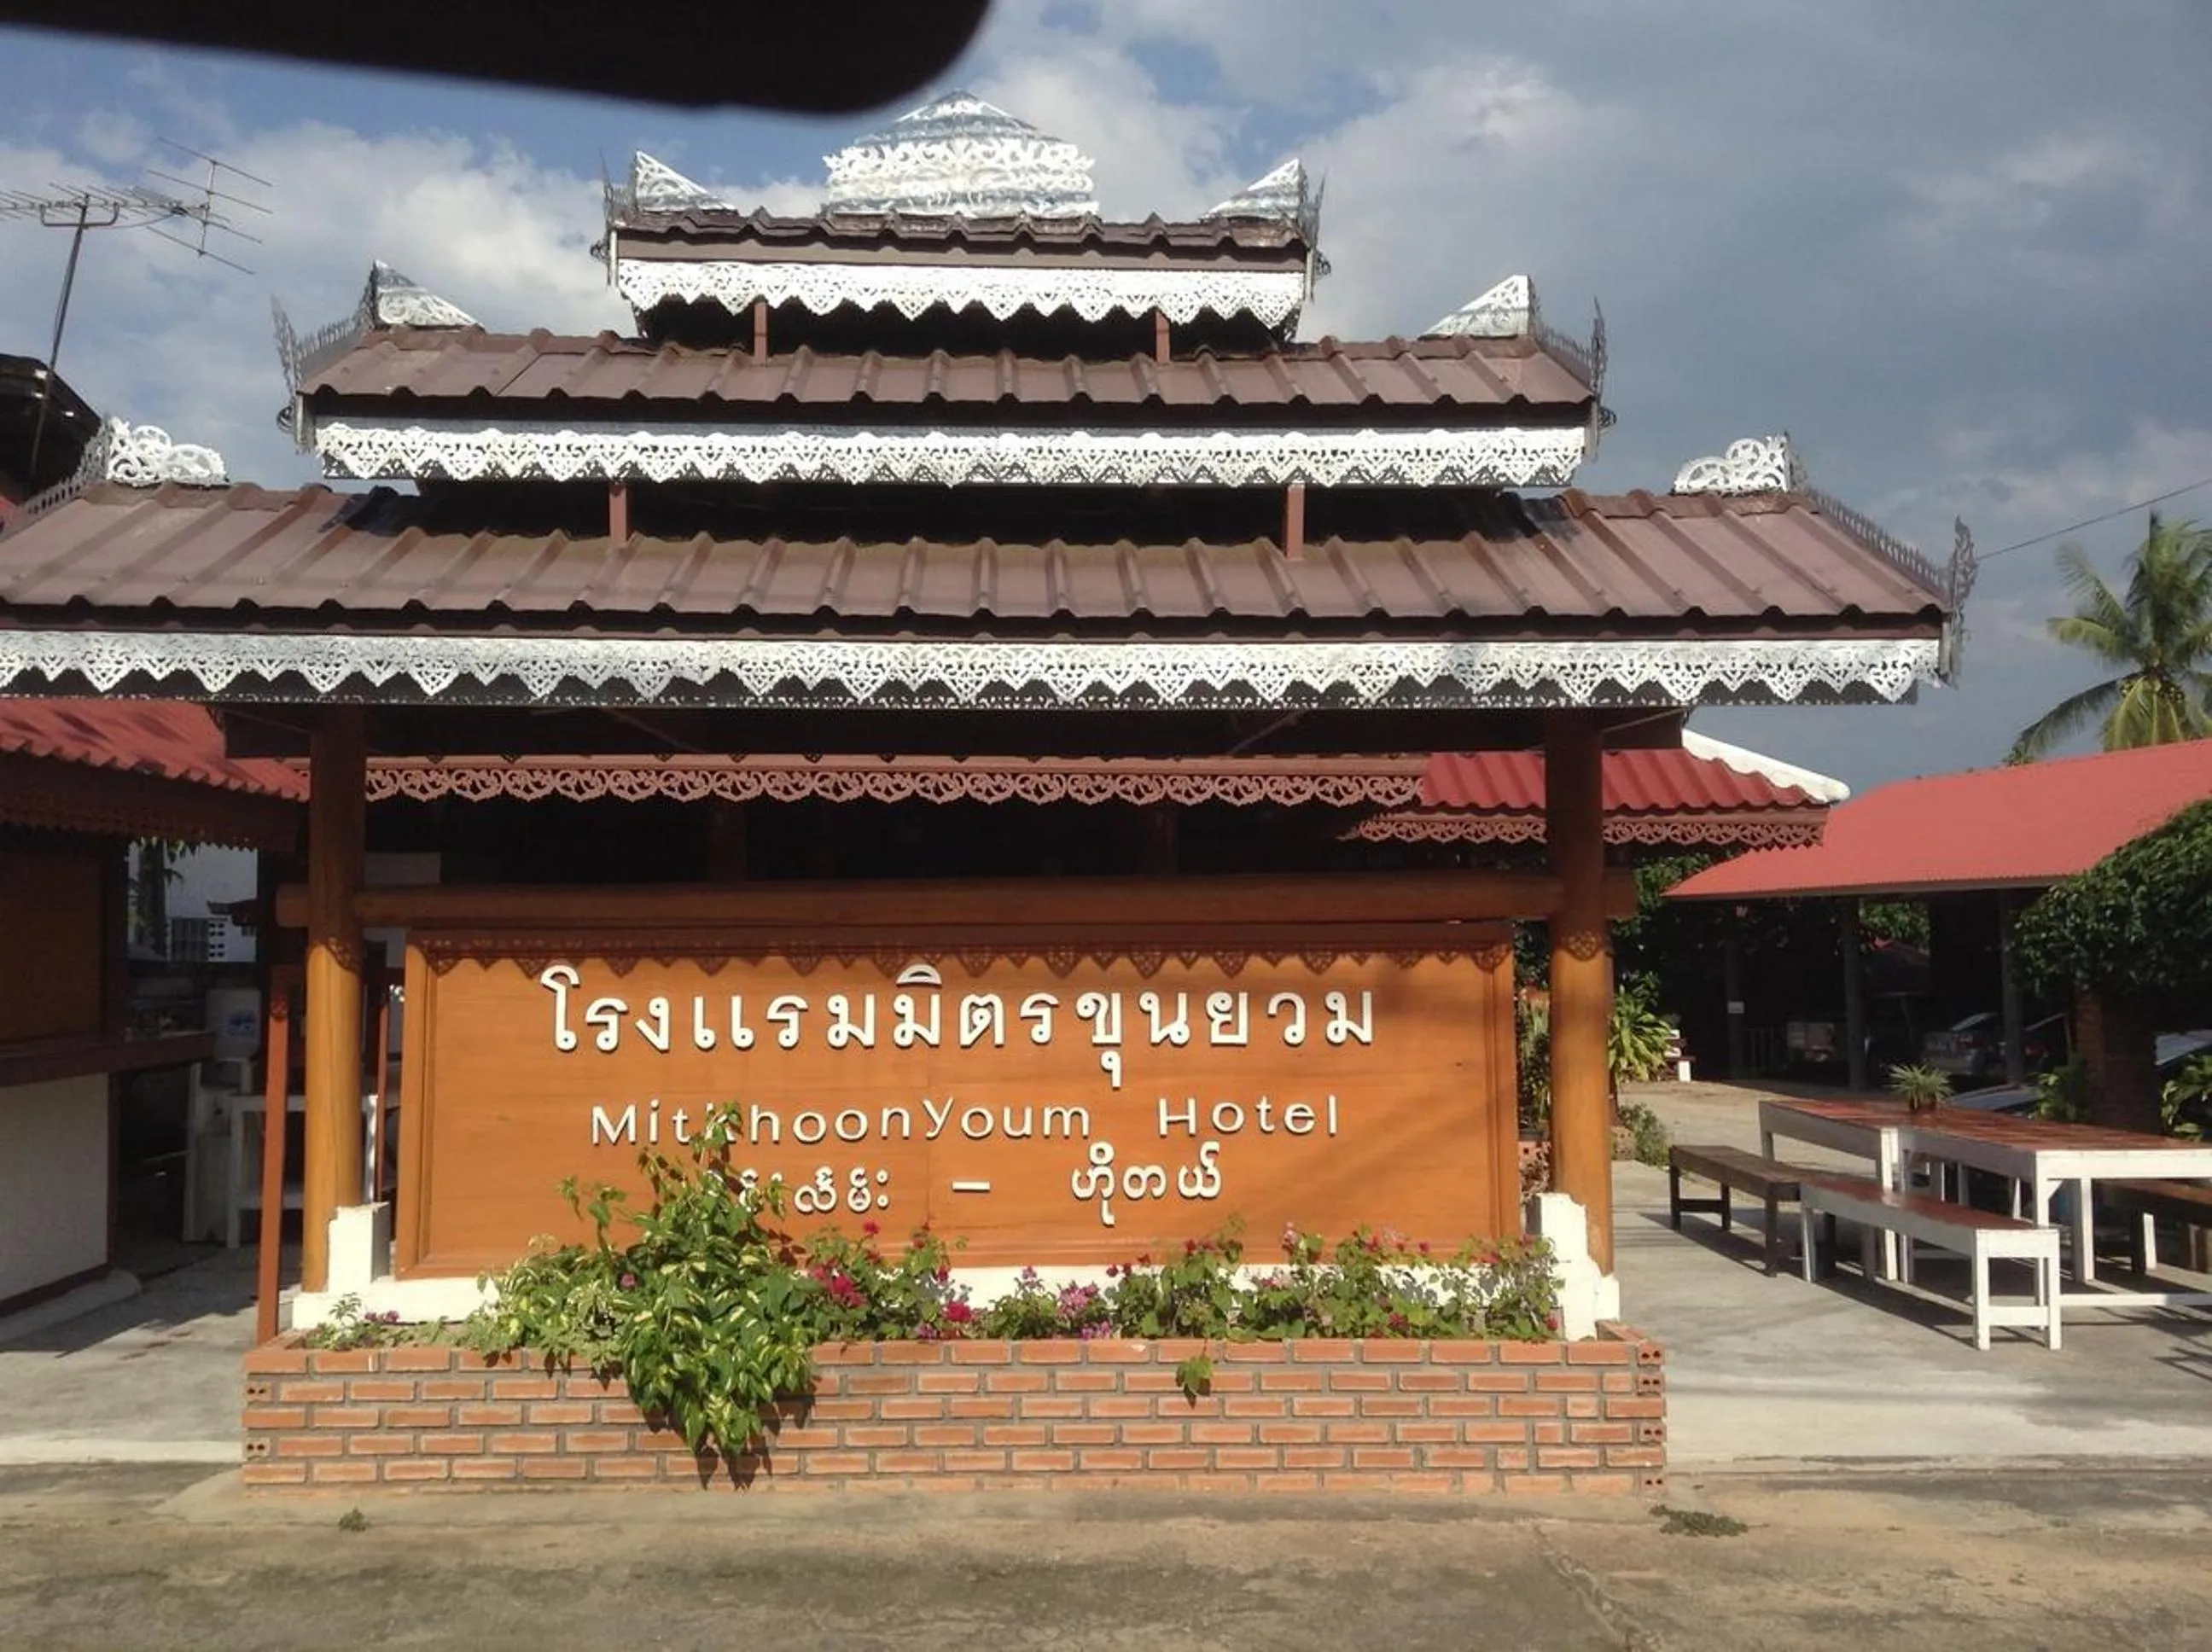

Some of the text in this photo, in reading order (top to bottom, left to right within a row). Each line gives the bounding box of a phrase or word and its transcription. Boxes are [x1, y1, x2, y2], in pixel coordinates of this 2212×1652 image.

[540, 963, 1373, 1088] โรงแรมมิตรขุนยวม
[1159, 1095, 1337, 1136] Hotel
